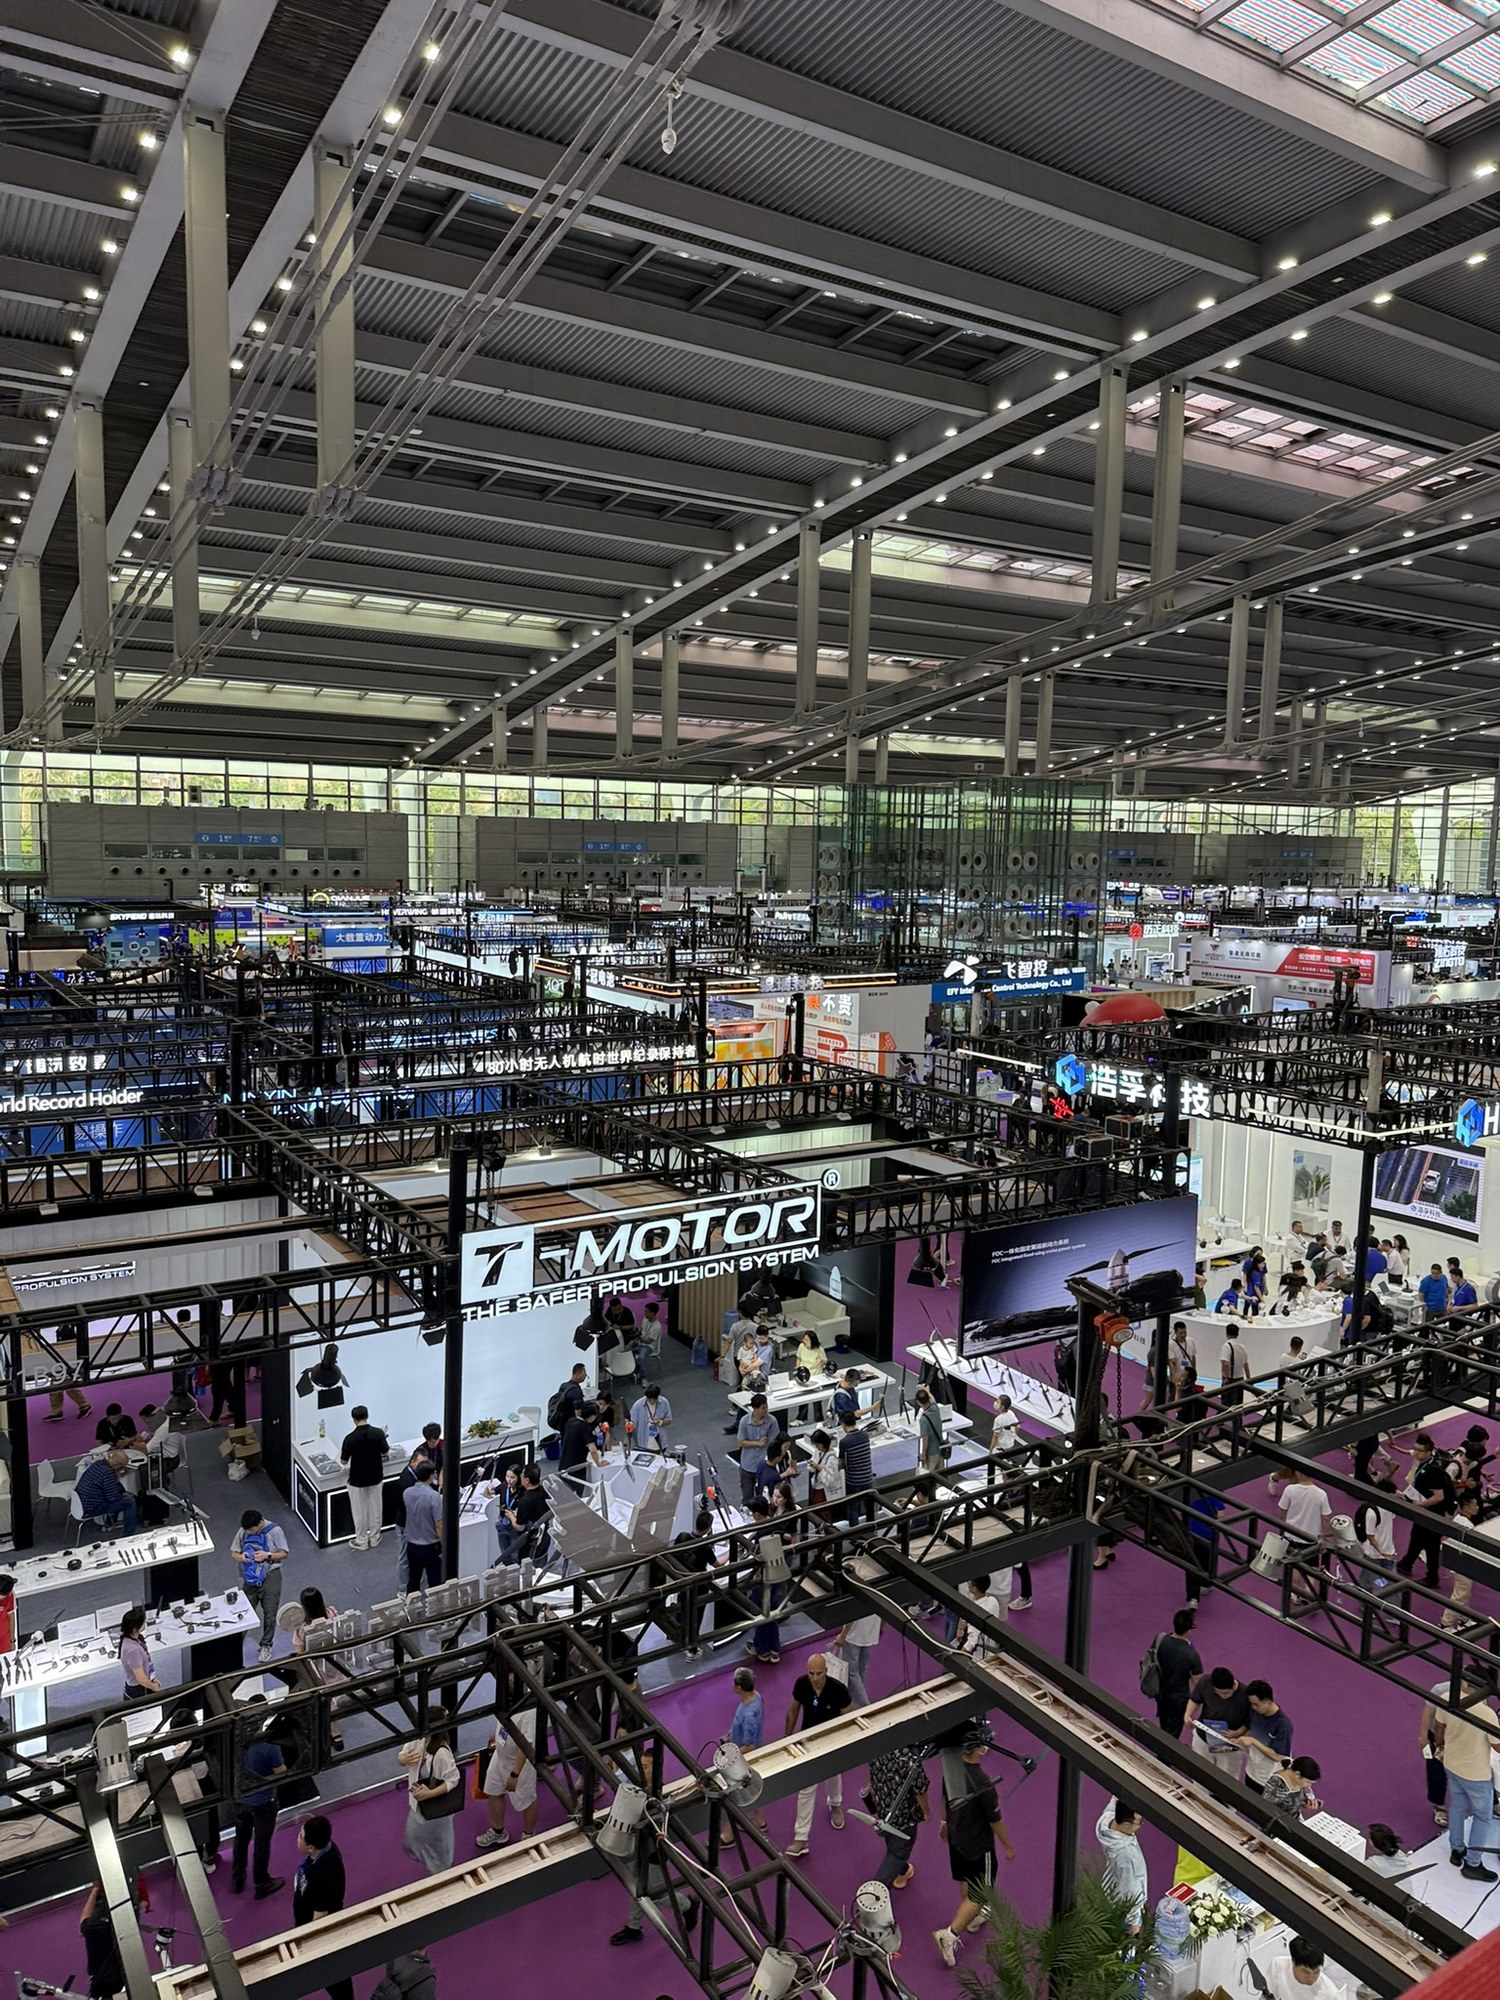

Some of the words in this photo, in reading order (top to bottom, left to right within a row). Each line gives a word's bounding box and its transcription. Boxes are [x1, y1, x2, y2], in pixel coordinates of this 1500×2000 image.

[987, 959, 1048, 979] 一飞智控
[992, 983, 1015, 992] Control
[1016, 981, 1049, 990] Technology
[487, 1045, 697, 1075] 80小时无人机航时世界纪录保持者
[28, 1091, 87, 1112] Record
[89, 1088, 144, 1110] Holder
[15, 1276, 88, 1291] PROPULSION
[90, 1269, 136, 1282] SYSTEM
[461, 1300, 511, 1322] THE
[516, 1287, 593, 1314] SAFER
[598, 1261, 735, 1298] PROPULSION
[739, 1245, 820, 1271] SYSTEM
[17, 1359, 84, 1391] 1B97
